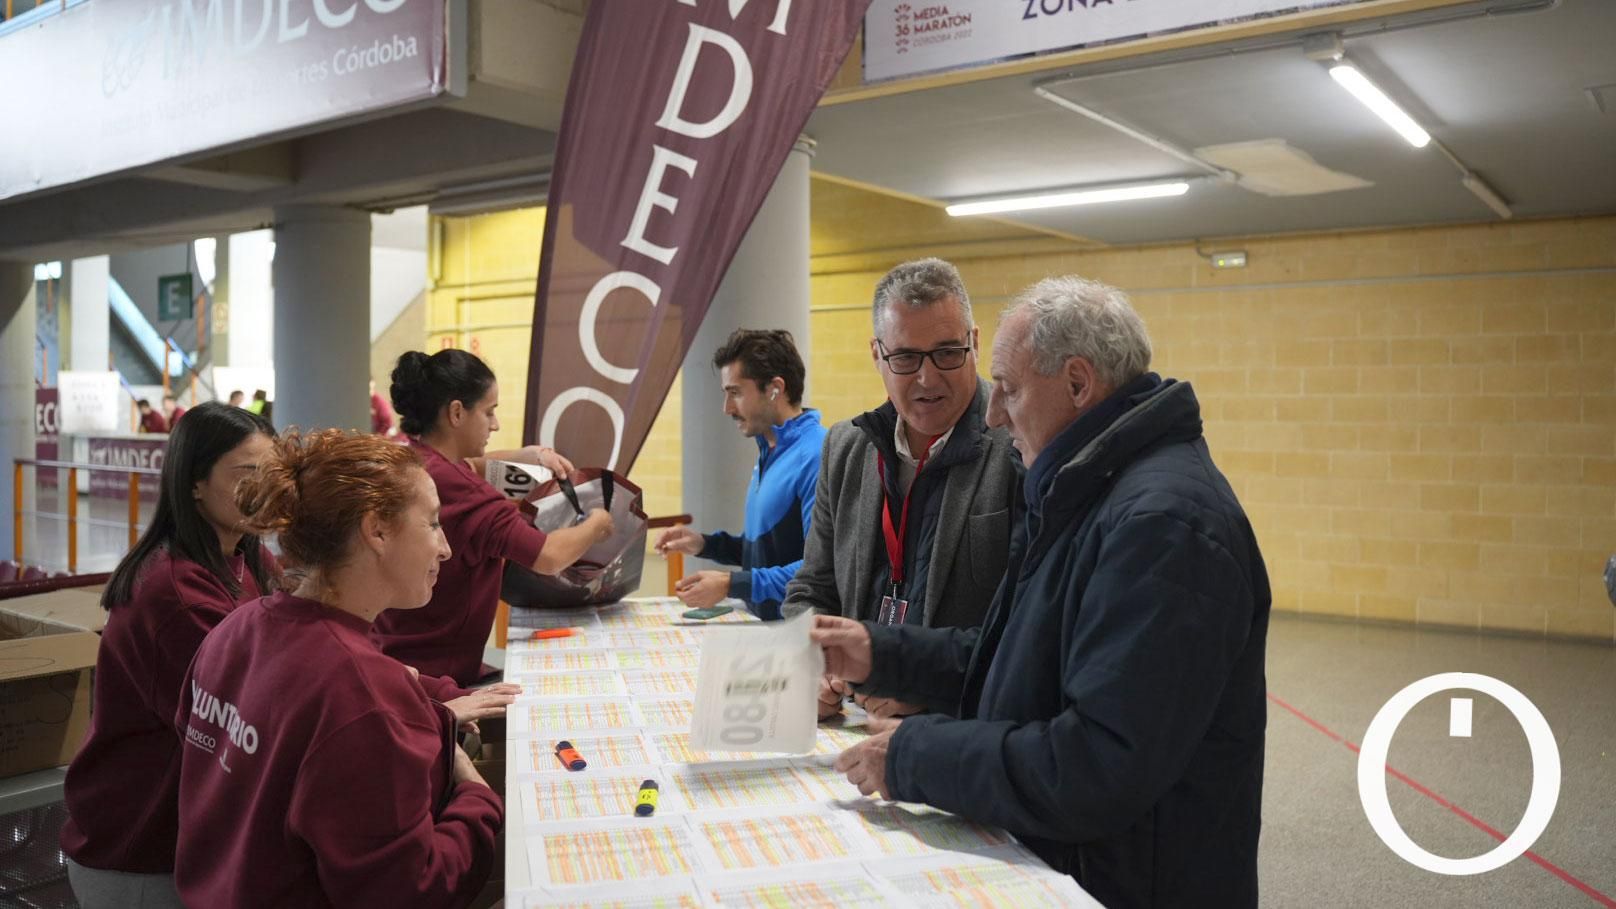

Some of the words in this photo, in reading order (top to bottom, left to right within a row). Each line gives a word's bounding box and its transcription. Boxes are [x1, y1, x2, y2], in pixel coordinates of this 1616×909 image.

[913, 6, 949, 22] MEDIA
[895, 25, 910, 37] 36
[913, 14, 972, 35] MARATÓN
[333, 34, 418, 75] Córdoba
